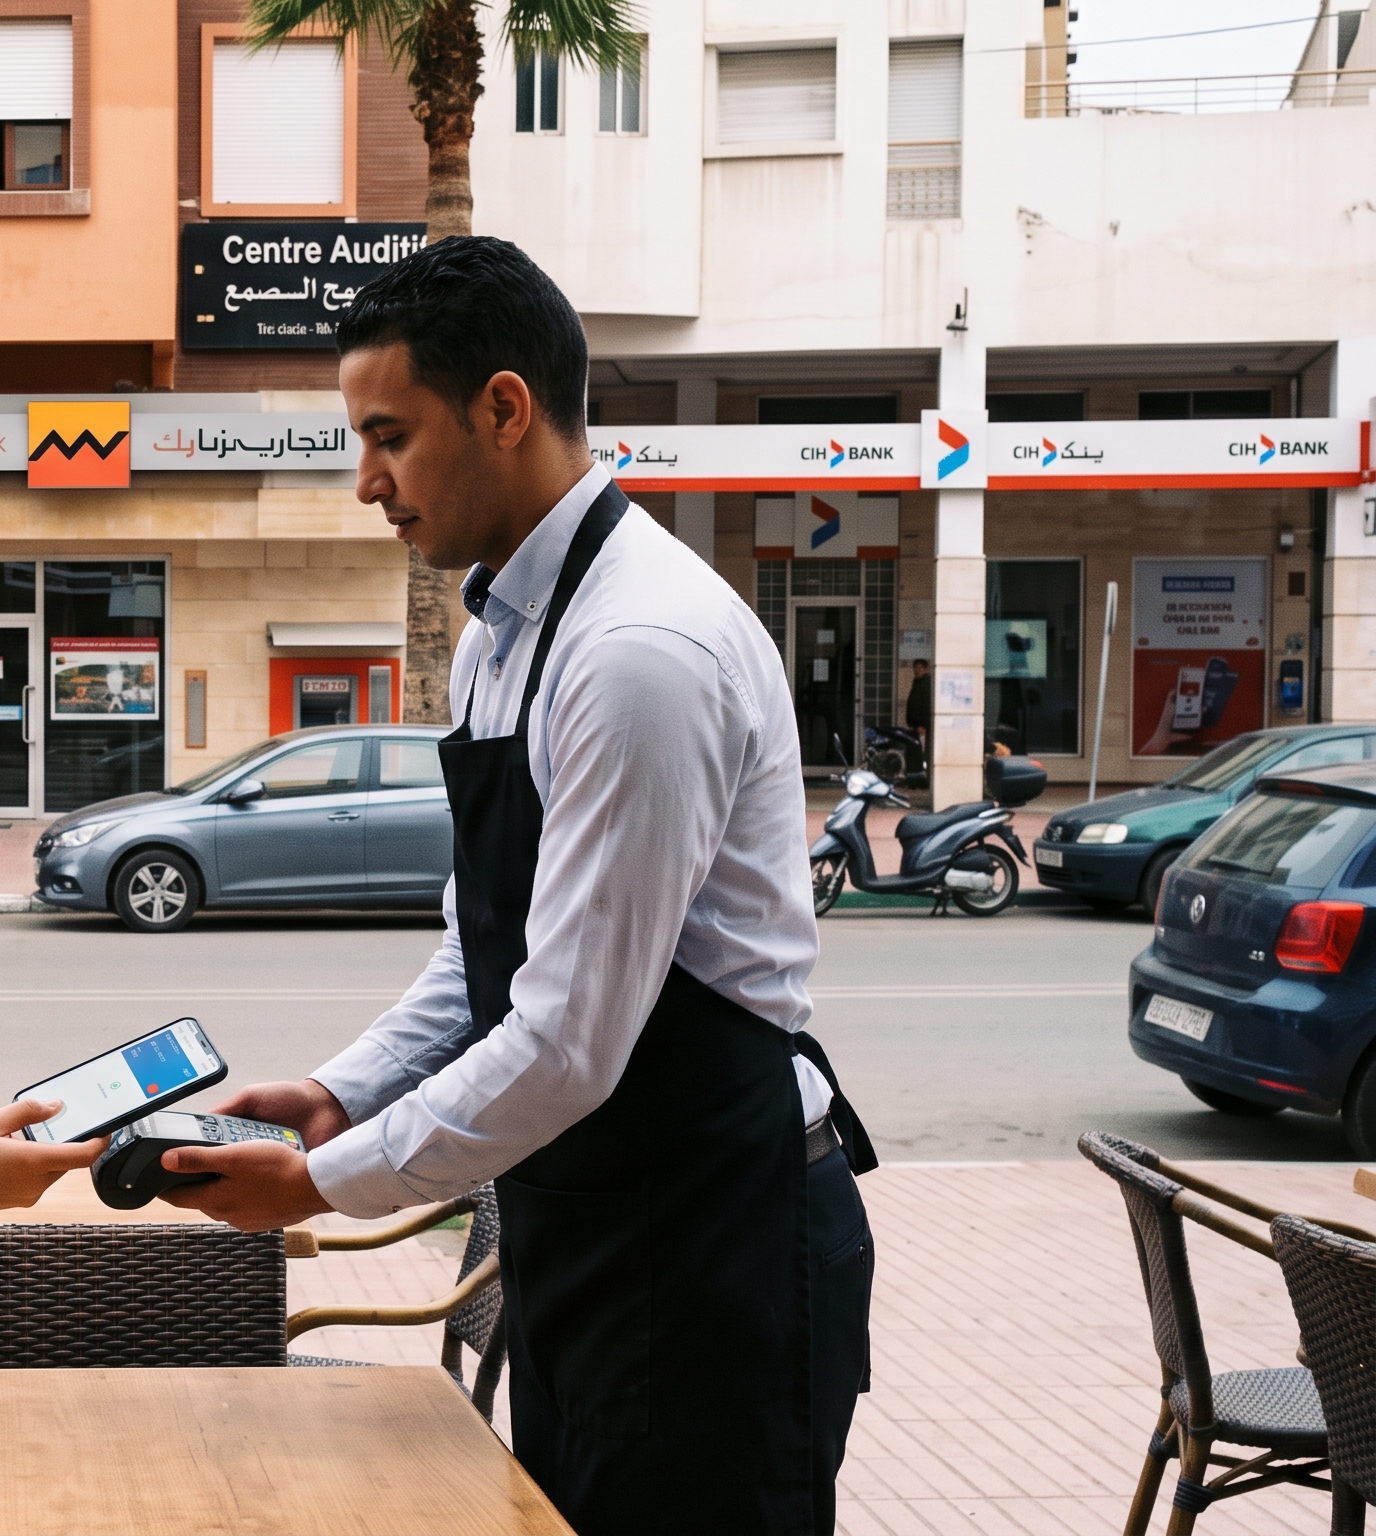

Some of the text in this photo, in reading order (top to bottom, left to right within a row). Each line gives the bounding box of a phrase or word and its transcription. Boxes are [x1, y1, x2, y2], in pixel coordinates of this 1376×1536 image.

[223, 235, 322, 264] Centre
[800, 446, 894, 460] CIH BANK
[1013, 445, 1039, 459] CIH
[1228, 441, 1329, 456] CIH BANK
